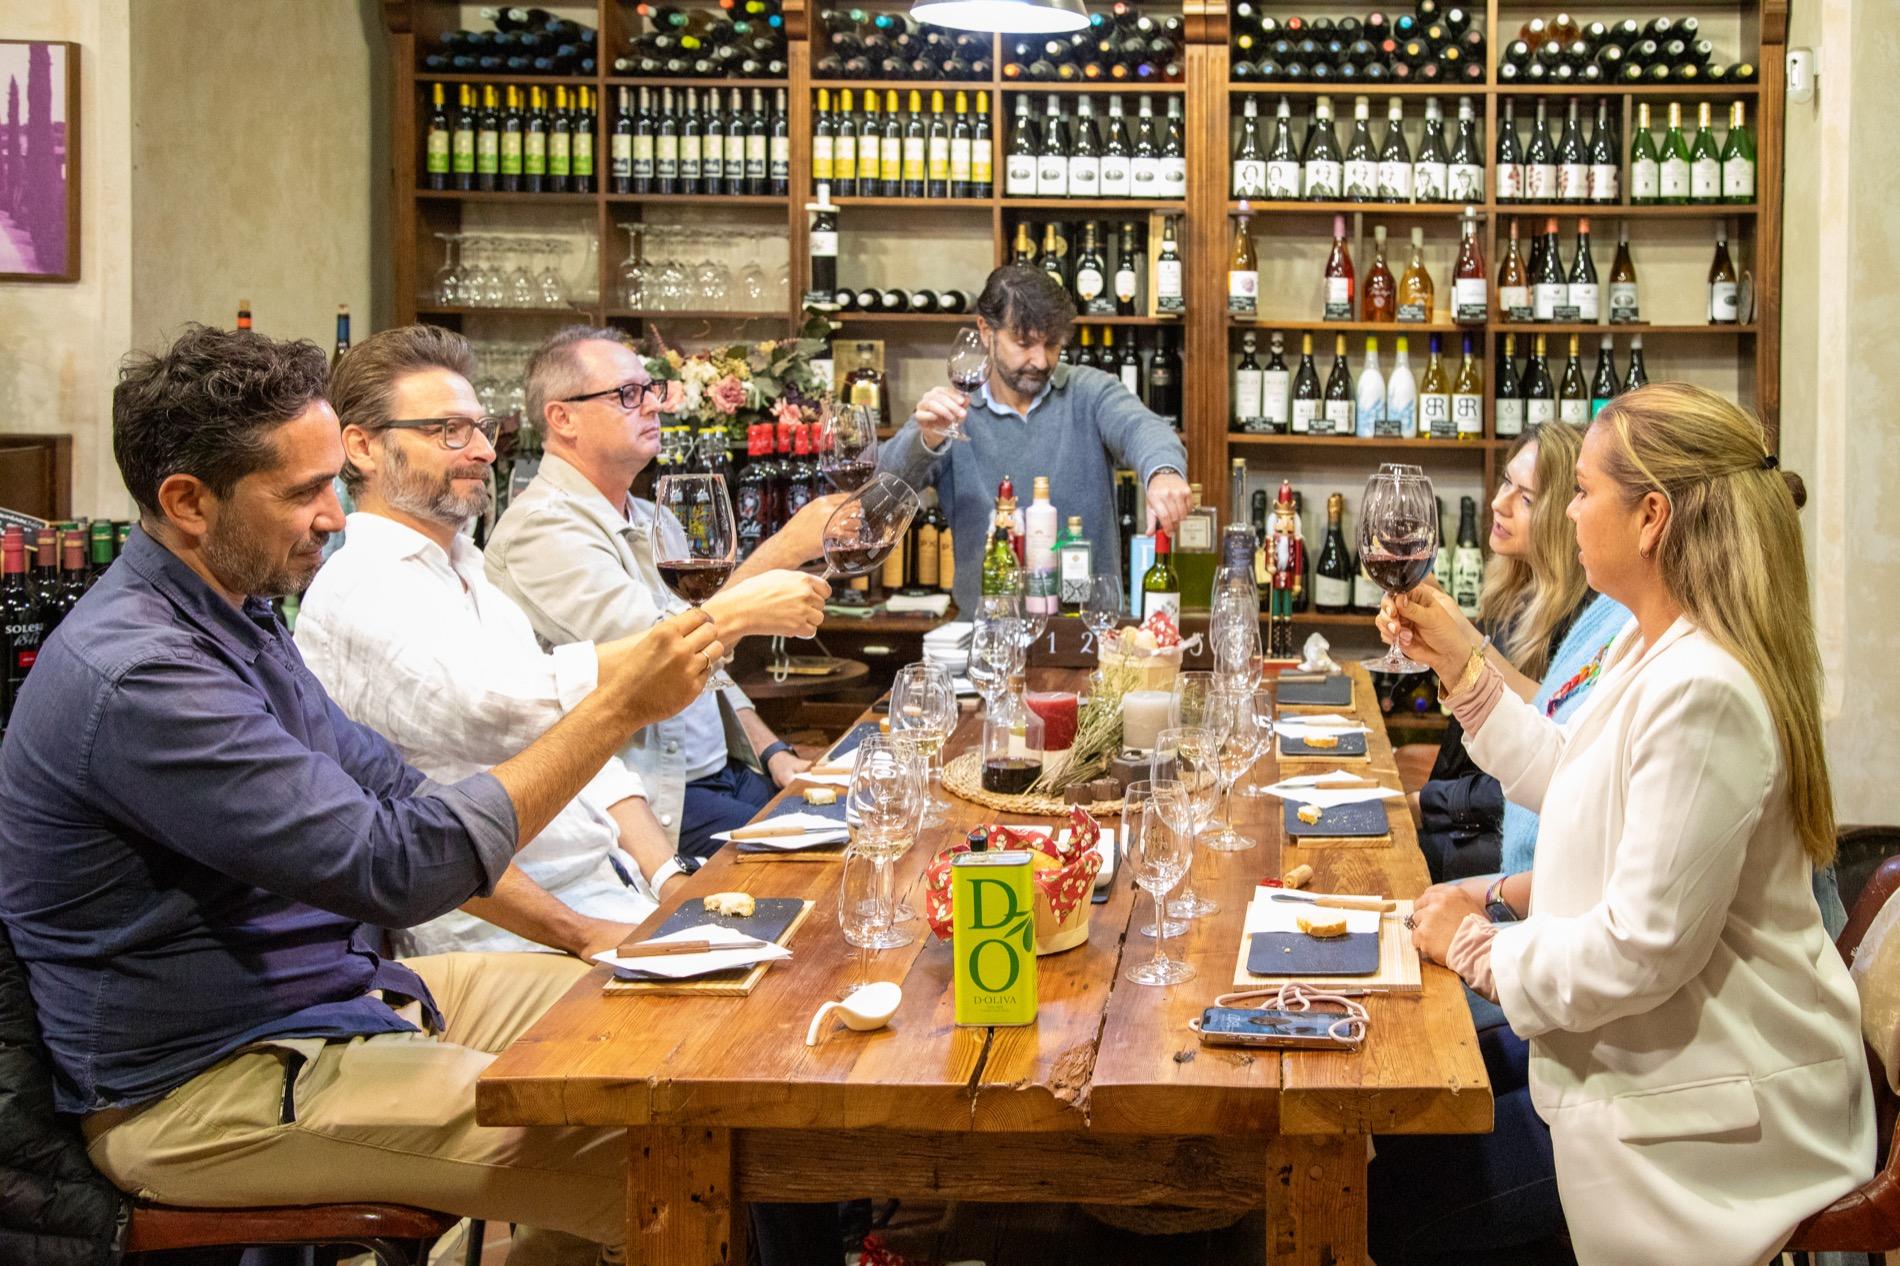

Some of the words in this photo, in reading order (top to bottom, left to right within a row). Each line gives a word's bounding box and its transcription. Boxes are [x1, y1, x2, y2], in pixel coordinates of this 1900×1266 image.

[1046, 632, 1057, 655] 1
[1080, 632, 1095, 655] 2
[966, 879, 1018, 930] D
[969, 938, 1020, 993] O
